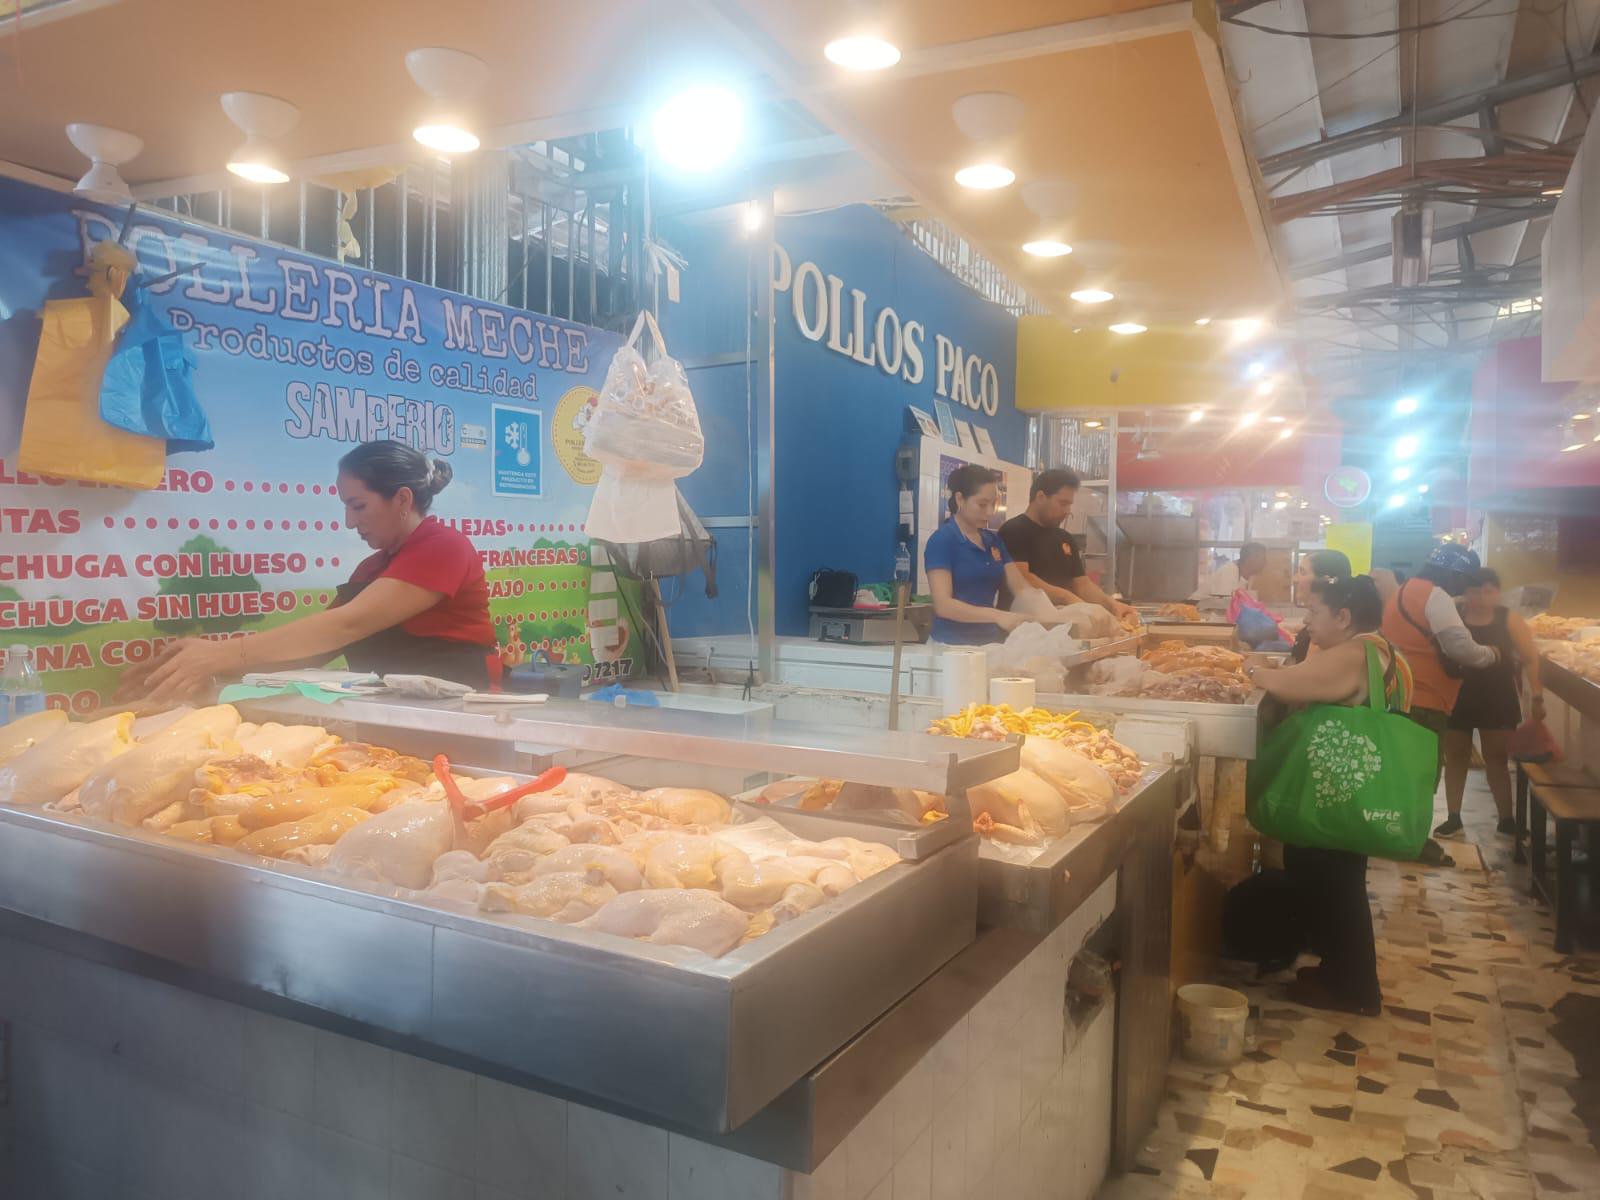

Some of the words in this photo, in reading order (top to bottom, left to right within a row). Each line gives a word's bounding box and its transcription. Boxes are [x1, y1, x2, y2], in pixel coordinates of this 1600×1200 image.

[72, 208, 428, 345] POLLERIA
[441, 298, 590, 375] MECHE
[769, 241, 924, 385] POLLOS
[935, 333, 999, 417] PACO
[168, 309, 374, 376] Productos
[383, 348, 422, 384] de
[428, 361, 539, 402] calidad
[285, 380, 456, 457] SAMPERIO
[135, 553, 201, 578] CON
[209, 552, 307, 576] HUESO
[137, 595, 191, 621] SIN
[198, 591, 297, 618] HUESO
